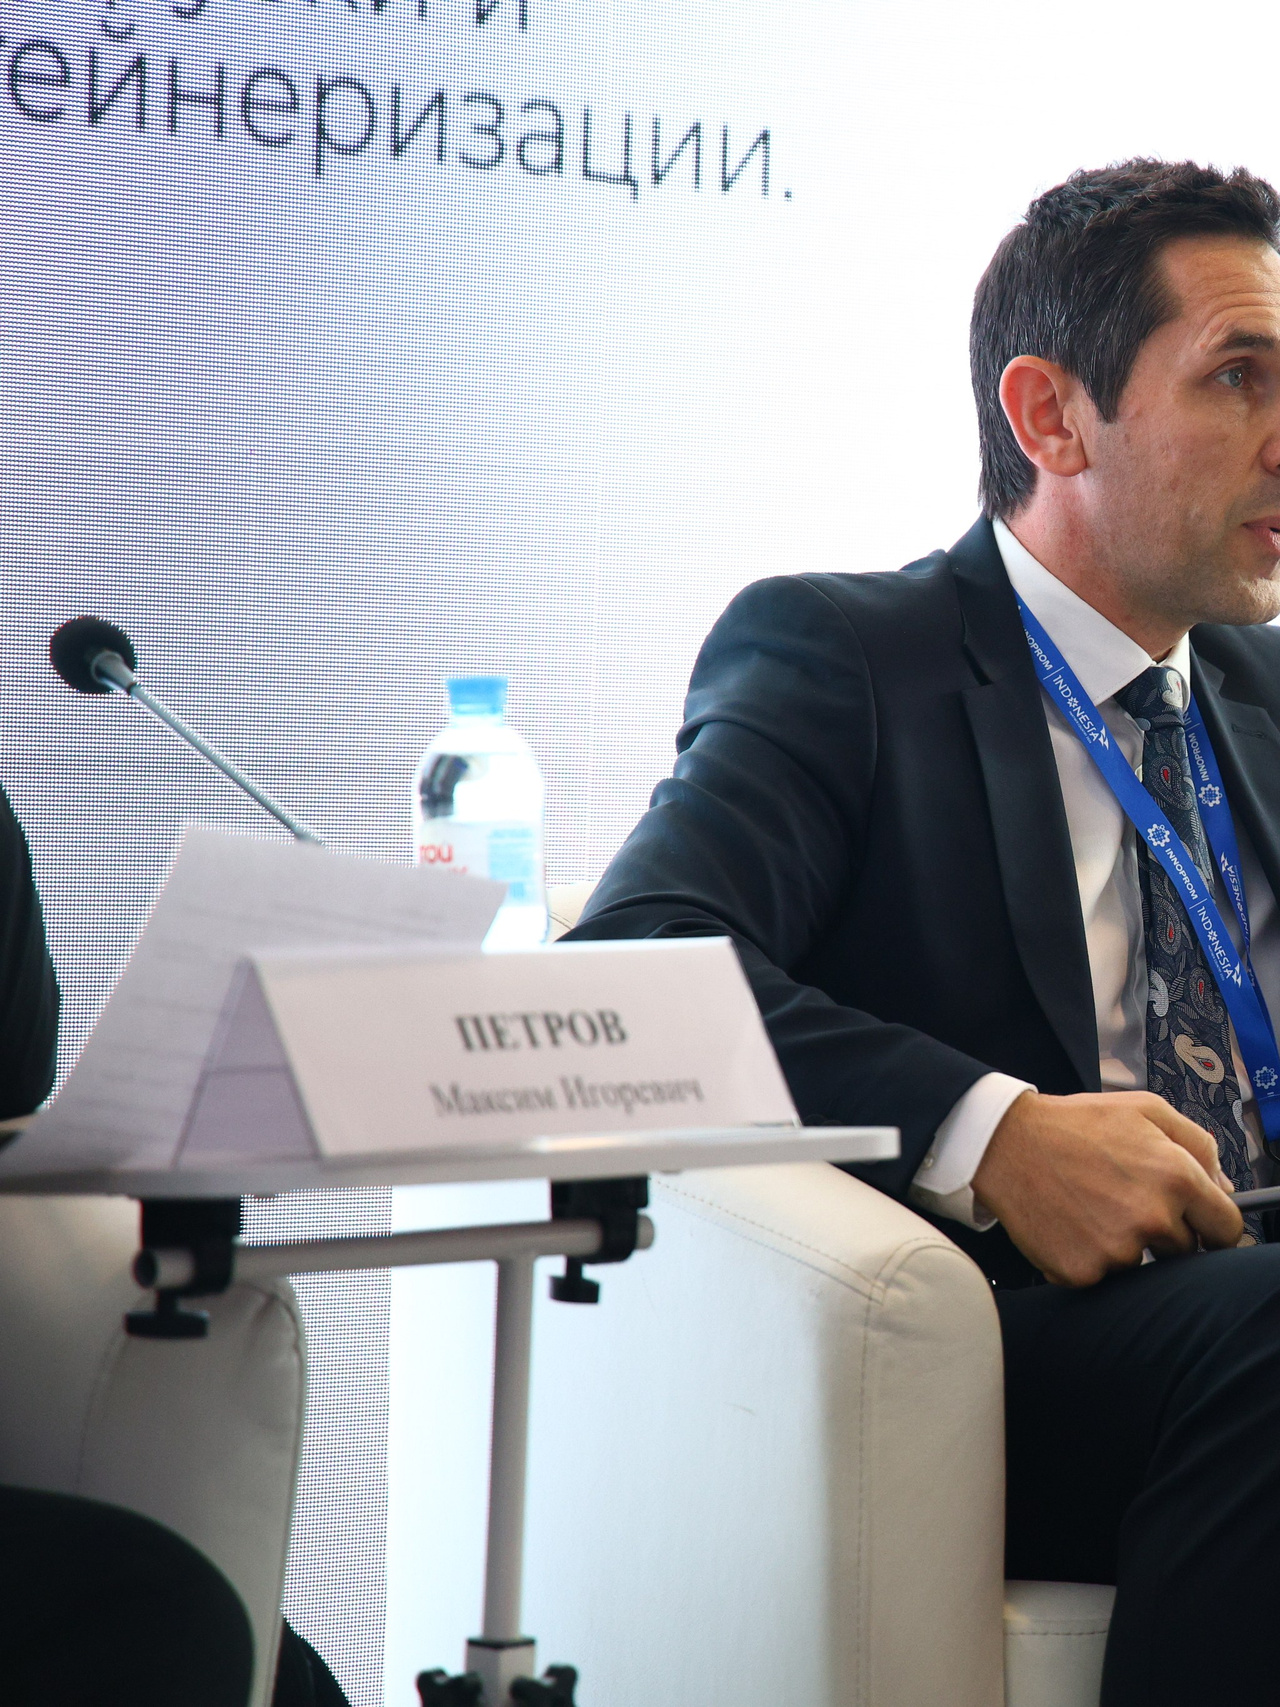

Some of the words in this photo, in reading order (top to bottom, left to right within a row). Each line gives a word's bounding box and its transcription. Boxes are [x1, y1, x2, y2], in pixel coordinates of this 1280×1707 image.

[0, 20, 795, 202] ейнеризации.
[1024, 628, 1053, 671] NOPROM
[1188, 732, 1210, 782] INNOPROM
[1165, 848, 1198, 900] INNOPROM
[454, 1008, 629, 1052] ПЕТРОВ
[429, 1081, 558, 1117] Максим
[559, 1074, 705, 1117] Игоревич
